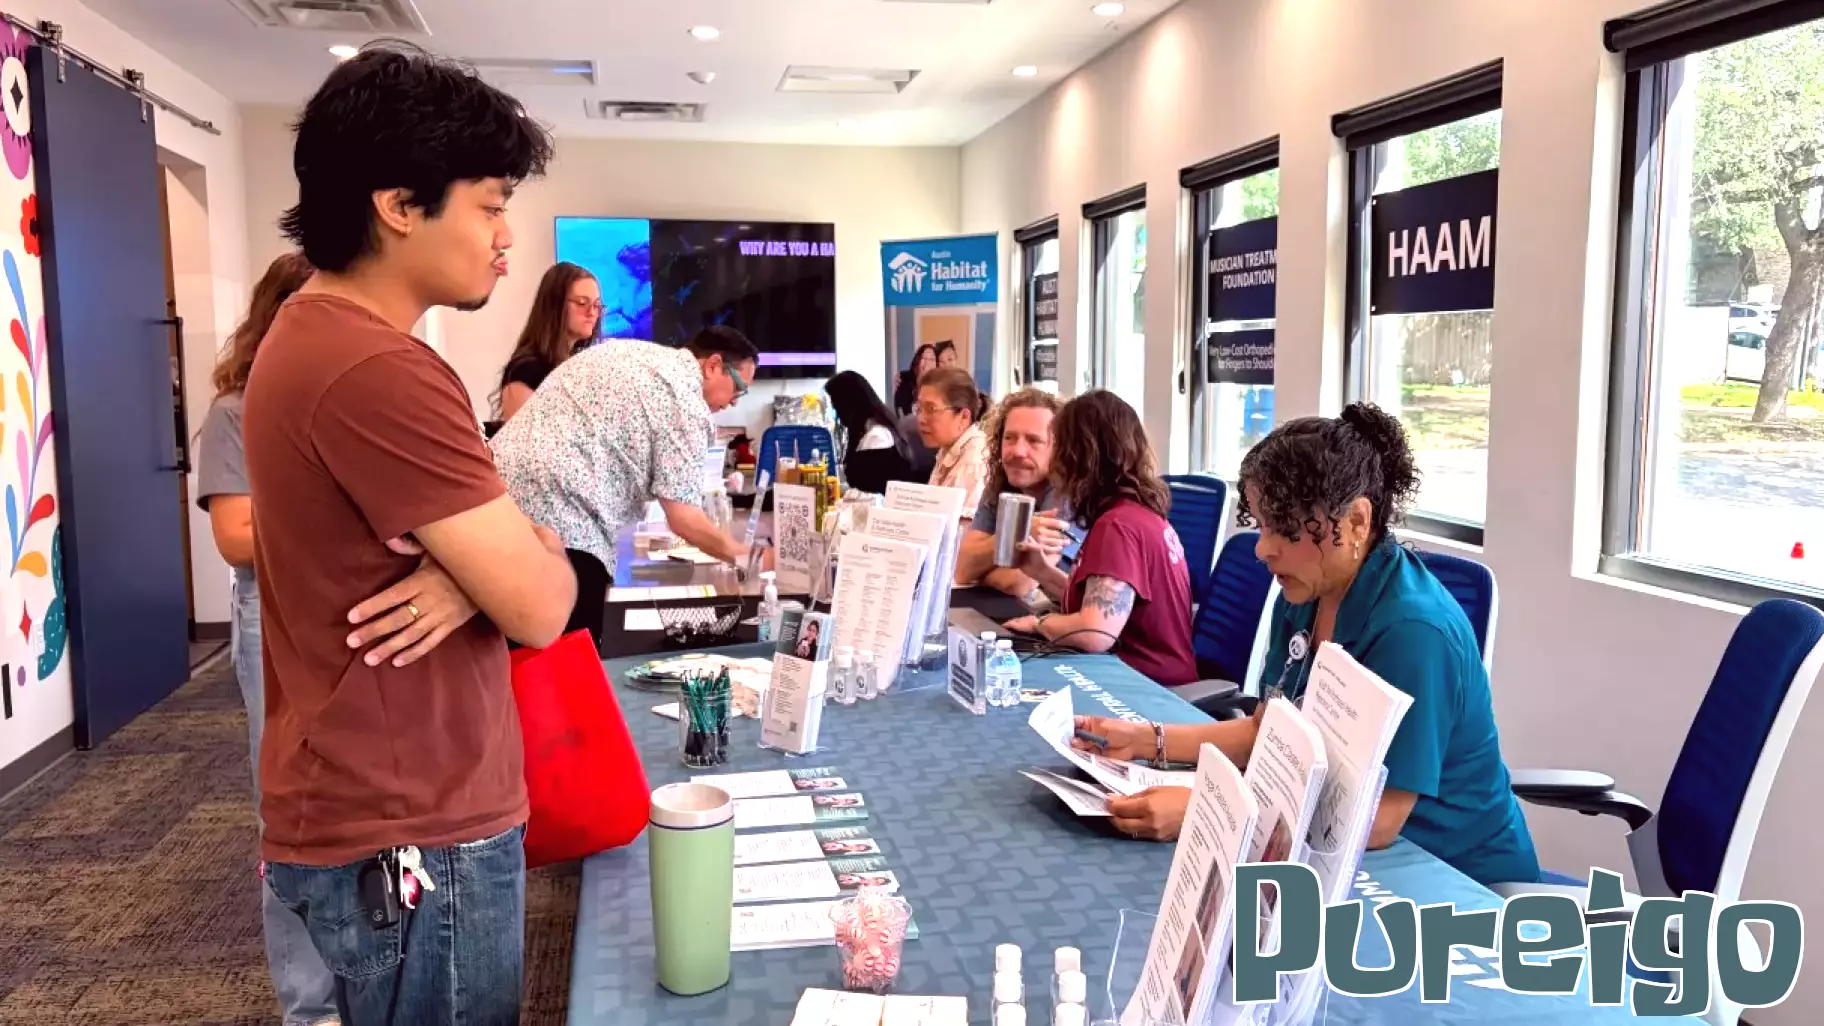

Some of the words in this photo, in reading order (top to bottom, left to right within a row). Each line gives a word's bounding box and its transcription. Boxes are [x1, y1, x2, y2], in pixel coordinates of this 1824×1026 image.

[739, 241, 765, 256] WHY
[766, 241, 788, 256] ARE
[788, 241, 809, 257] YOU
[810, 242, 819, 256] A
[1388, 215, 1491, 278] HAAM
[931, 260, 988, 280] Habitat
[1210, 254, 1244, 274] MUSICIAN
[931, 280, 944, 291] for
[945, 280, 988, 293] Humanity
[1223, 268, 1275, 290] FOUNDATION
